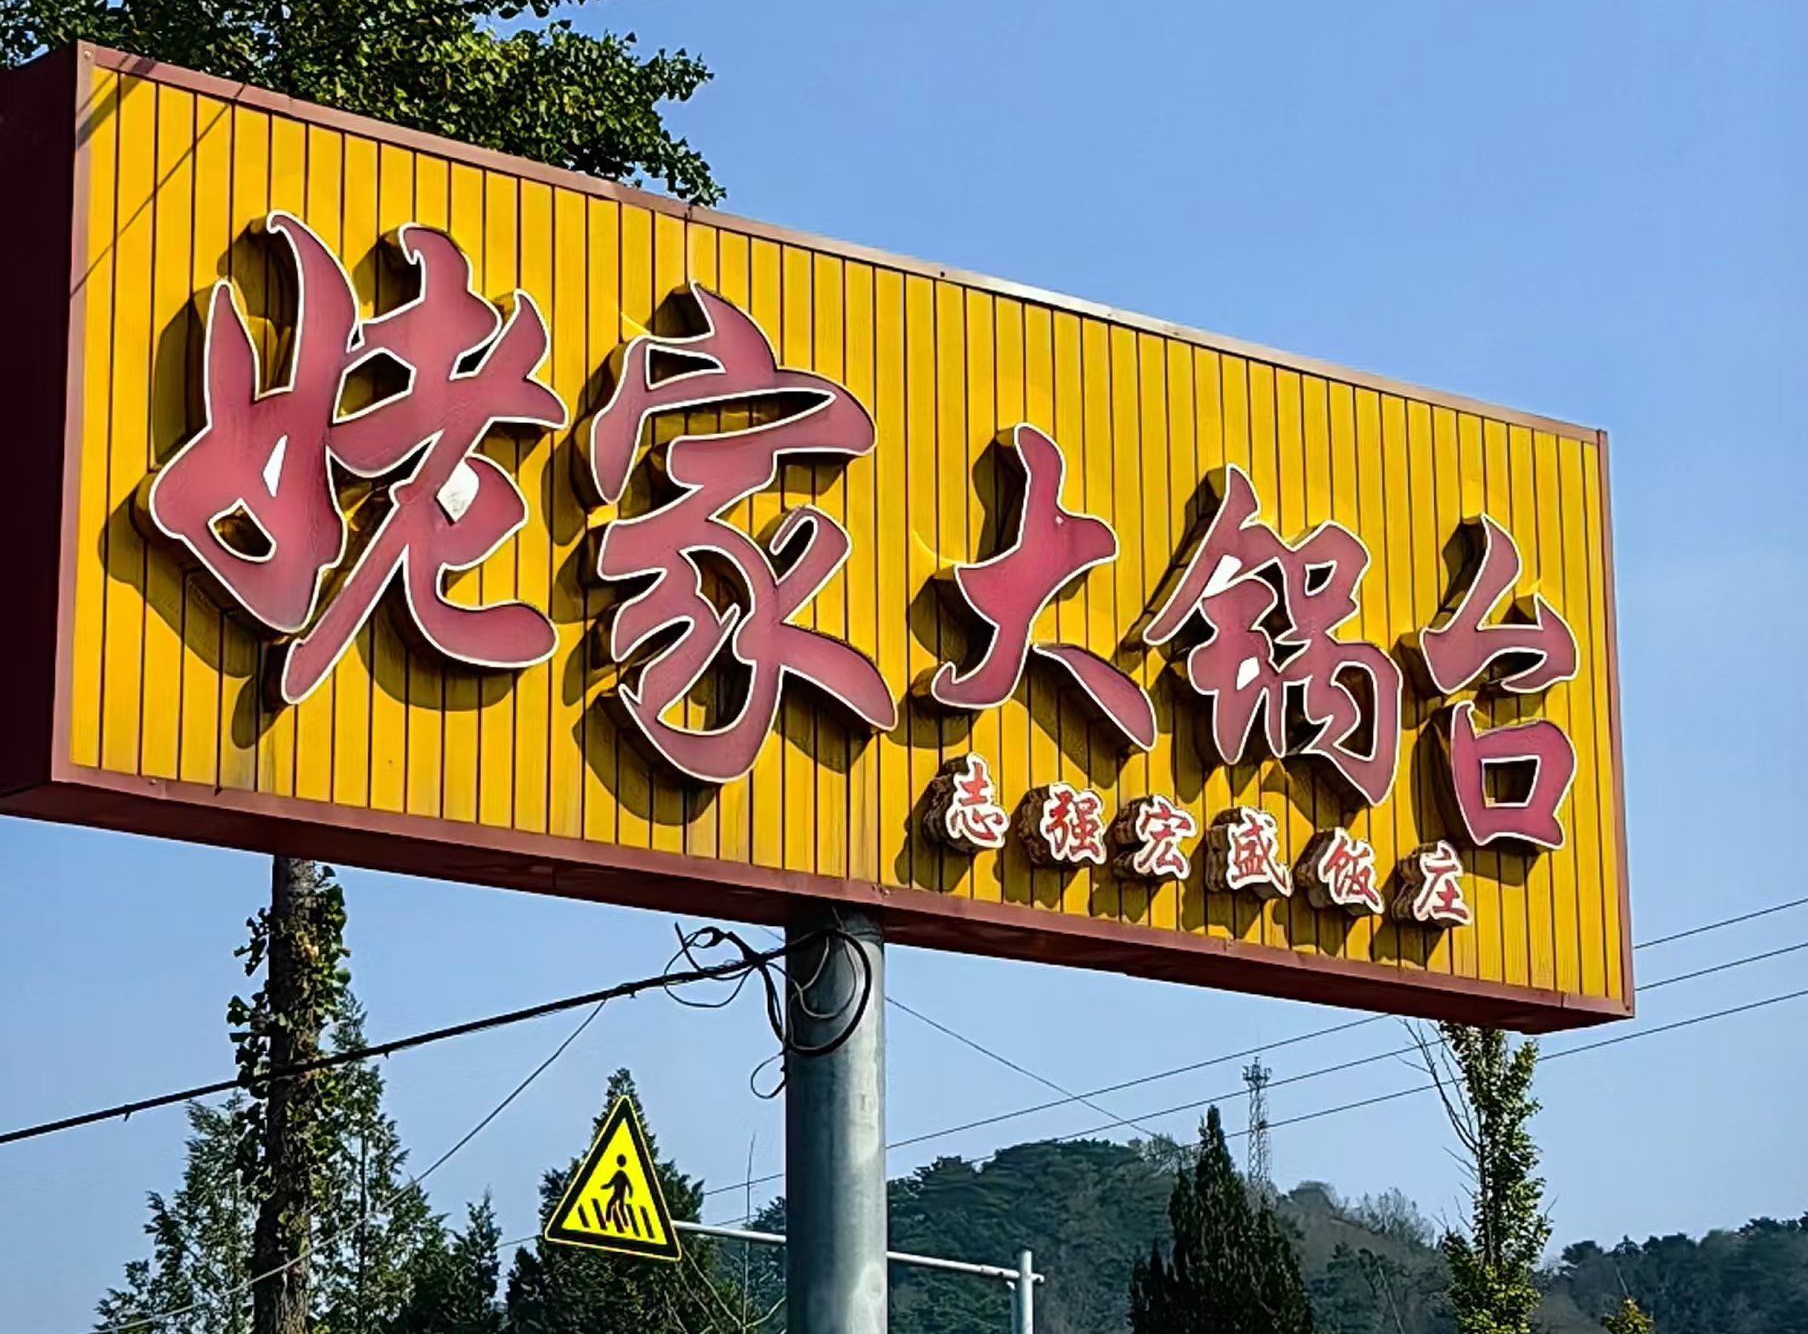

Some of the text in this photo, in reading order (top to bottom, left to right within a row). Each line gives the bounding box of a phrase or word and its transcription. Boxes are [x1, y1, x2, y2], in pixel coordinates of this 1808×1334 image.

[150, 210, 1579, 850] 姥家大锅台
[945, 753, 1473, 926] 志强宏盛饭庄
